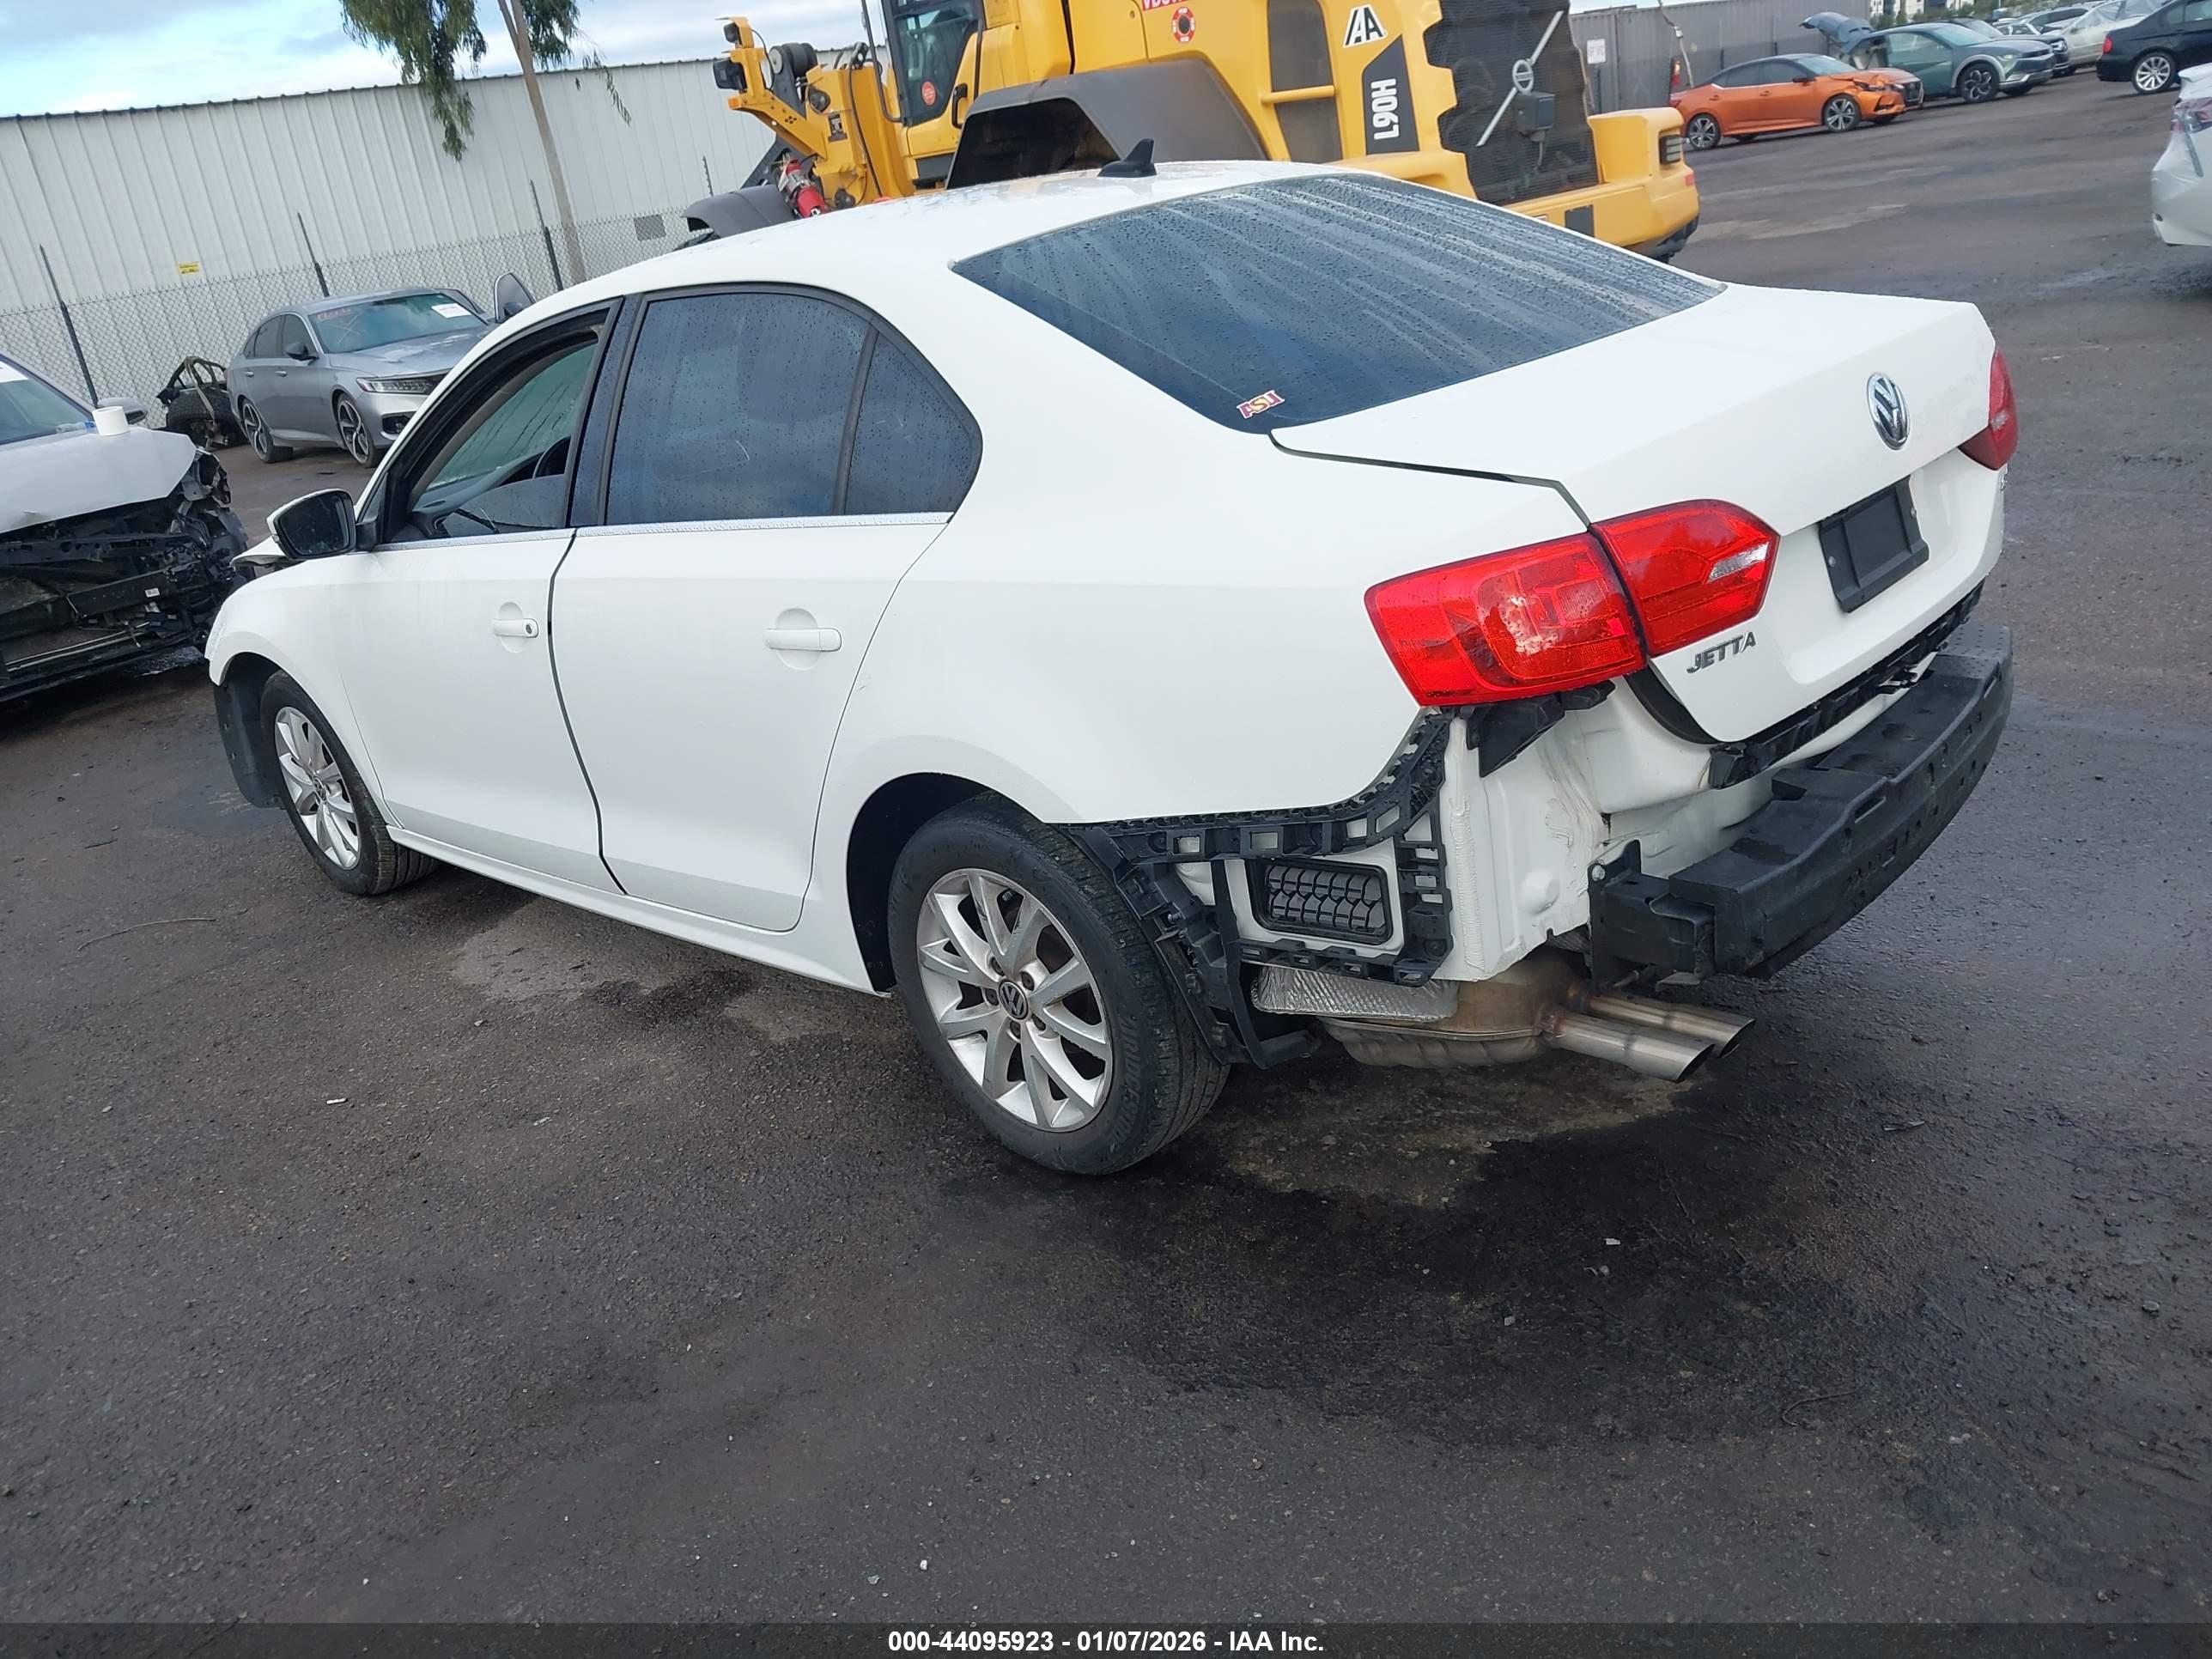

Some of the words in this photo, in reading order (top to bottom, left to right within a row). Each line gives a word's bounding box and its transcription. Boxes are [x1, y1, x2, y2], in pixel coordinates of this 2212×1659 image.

[1370, 78, 1400, 140] L90H
[1237, 390, 1285, 419] ASU
[1686, 631, 1757, 674] JETTA
